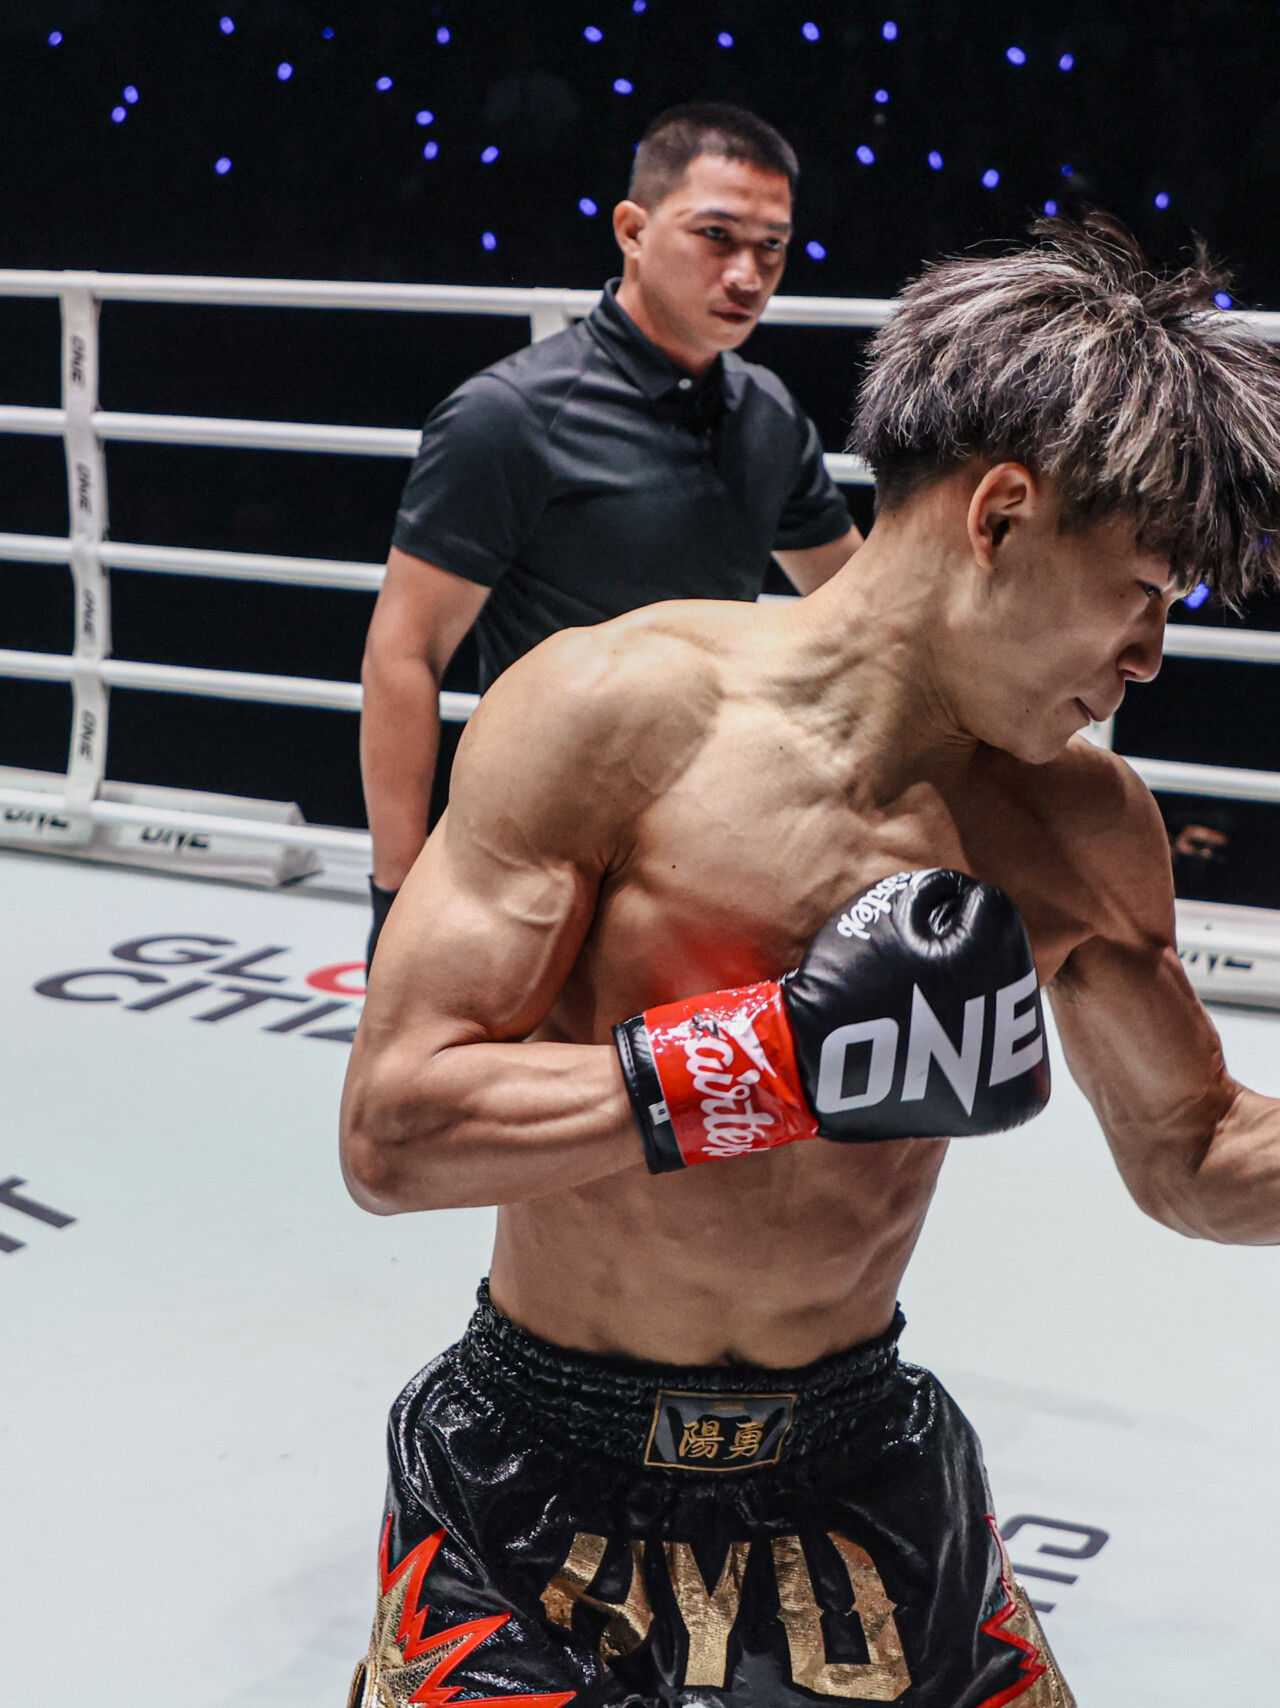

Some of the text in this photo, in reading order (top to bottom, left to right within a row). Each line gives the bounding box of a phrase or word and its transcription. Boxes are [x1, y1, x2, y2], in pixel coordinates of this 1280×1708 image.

[69, 334, 87, 389] ONE
[75, 461, 92, 515] ONE
[79, 708, 97, 762] ONE
[815, 967, 1044, 1118] ONE
[678, 1419, 765, 1460] 陽勇
